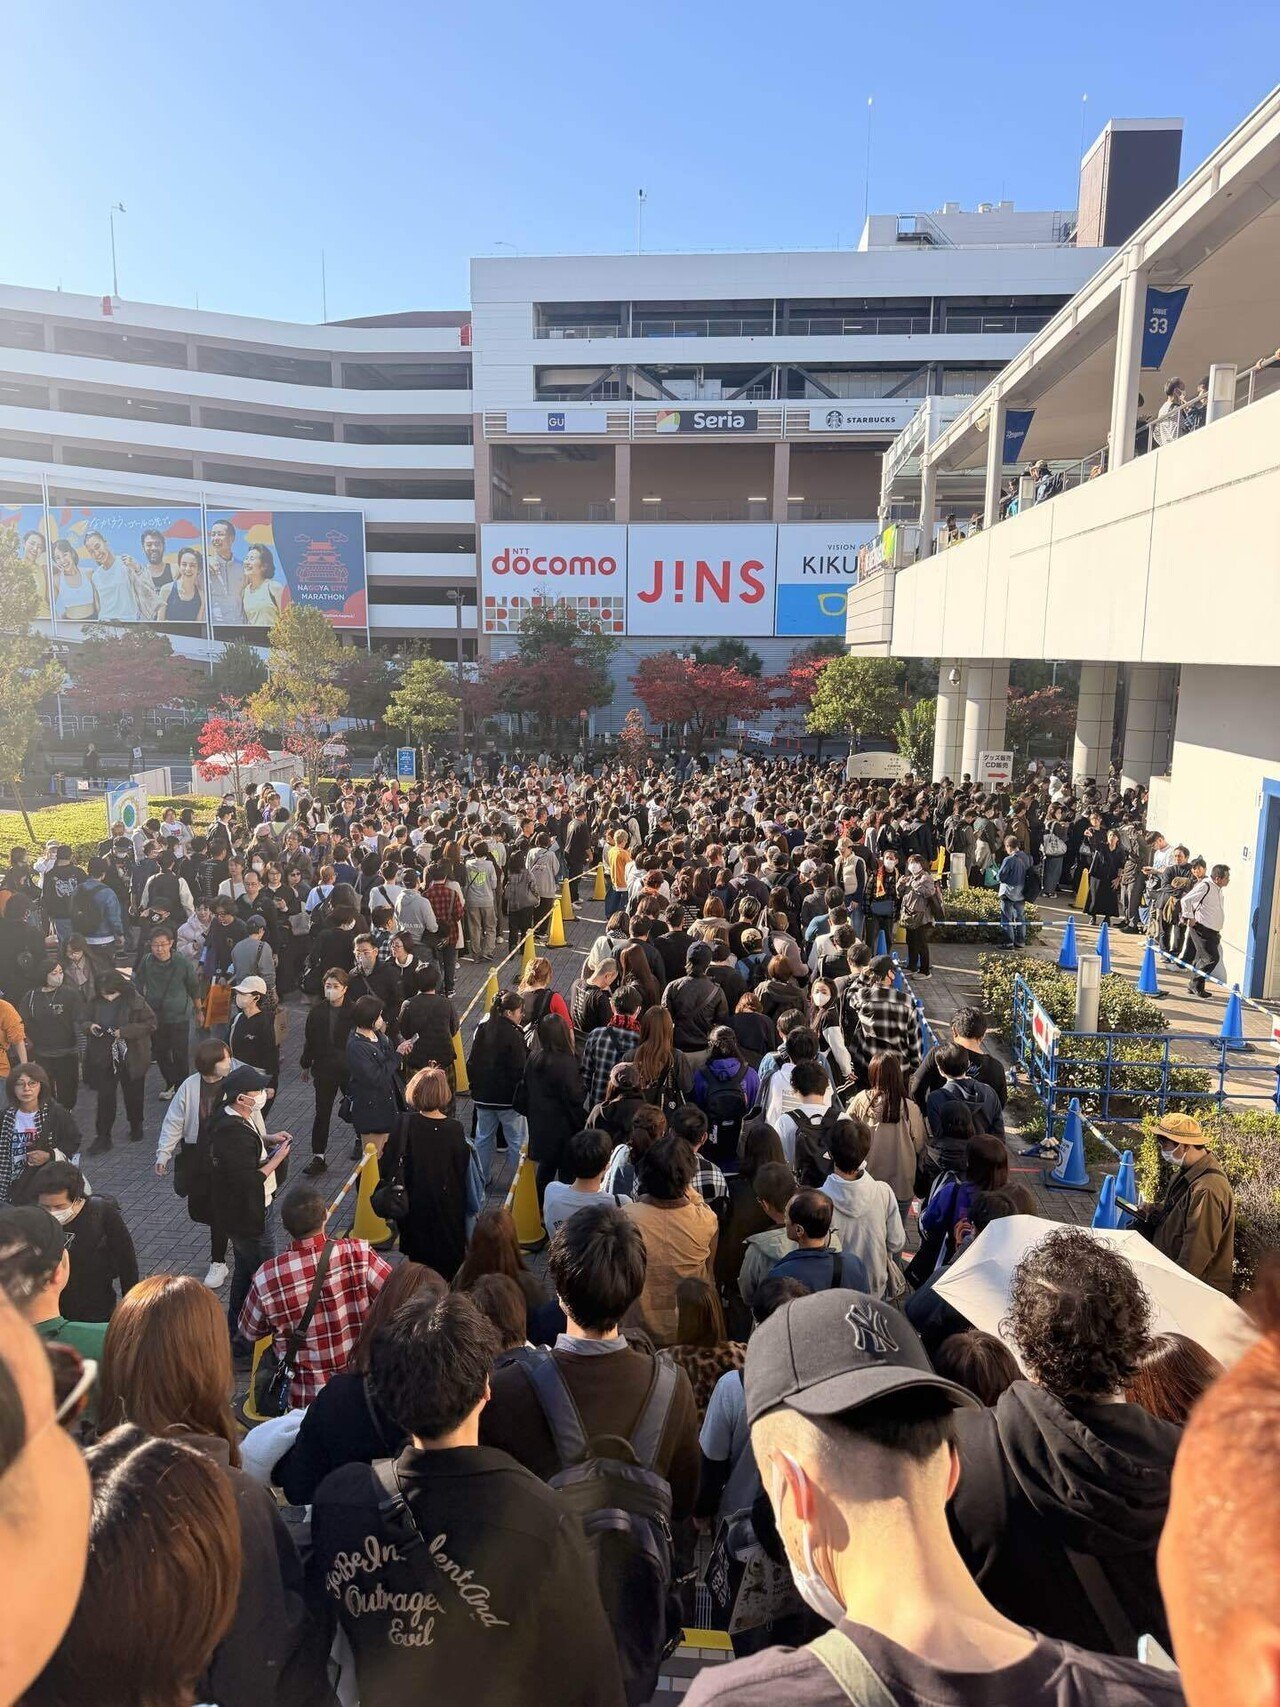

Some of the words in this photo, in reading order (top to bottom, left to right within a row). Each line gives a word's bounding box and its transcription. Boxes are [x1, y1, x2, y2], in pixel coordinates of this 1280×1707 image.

[1149, 317, 1168, 334] 33
[549, 418, 565, 427] GU
[693, 410, 746, 429] Seria
[846, 416, 896, 424] STARBUCKS
[512, 547, 530, 555] NTT
[491, 547, 617, 576] docomo
[802, 556, 859, 574] KIKU
[297, 584, 329, 592] NAGOYA
[331, 584, 349, 592] CITY
[301, 593, 345, 601] MARATHON
[845, 1304, 900, 1352] NY
[345, 1582, 447, 1627] Outrage
[388, 1617, 436, 1647] Evil
